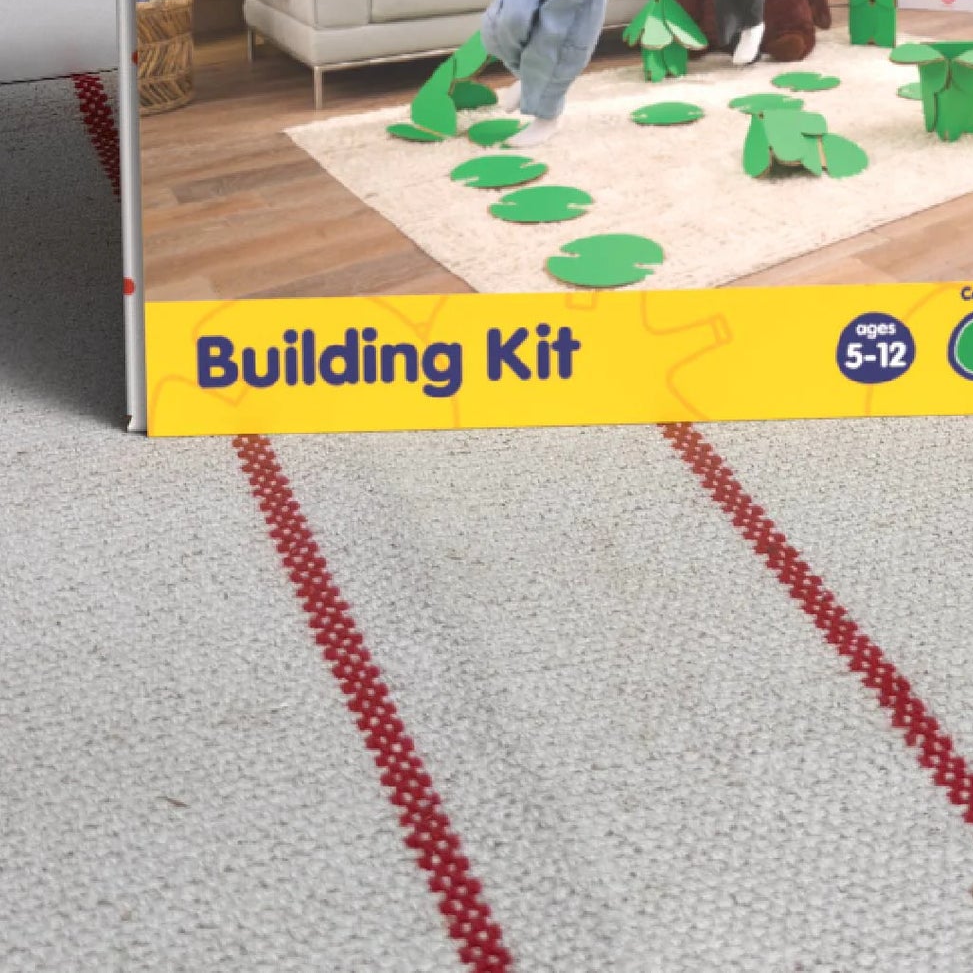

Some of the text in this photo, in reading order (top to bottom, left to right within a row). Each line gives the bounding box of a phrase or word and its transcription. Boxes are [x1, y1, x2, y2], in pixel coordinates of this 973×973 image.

[856, 323, 896, 339] ages
[197, 323, 581, 397] Building Kit
[845, 342, 907, 369] 5-12
